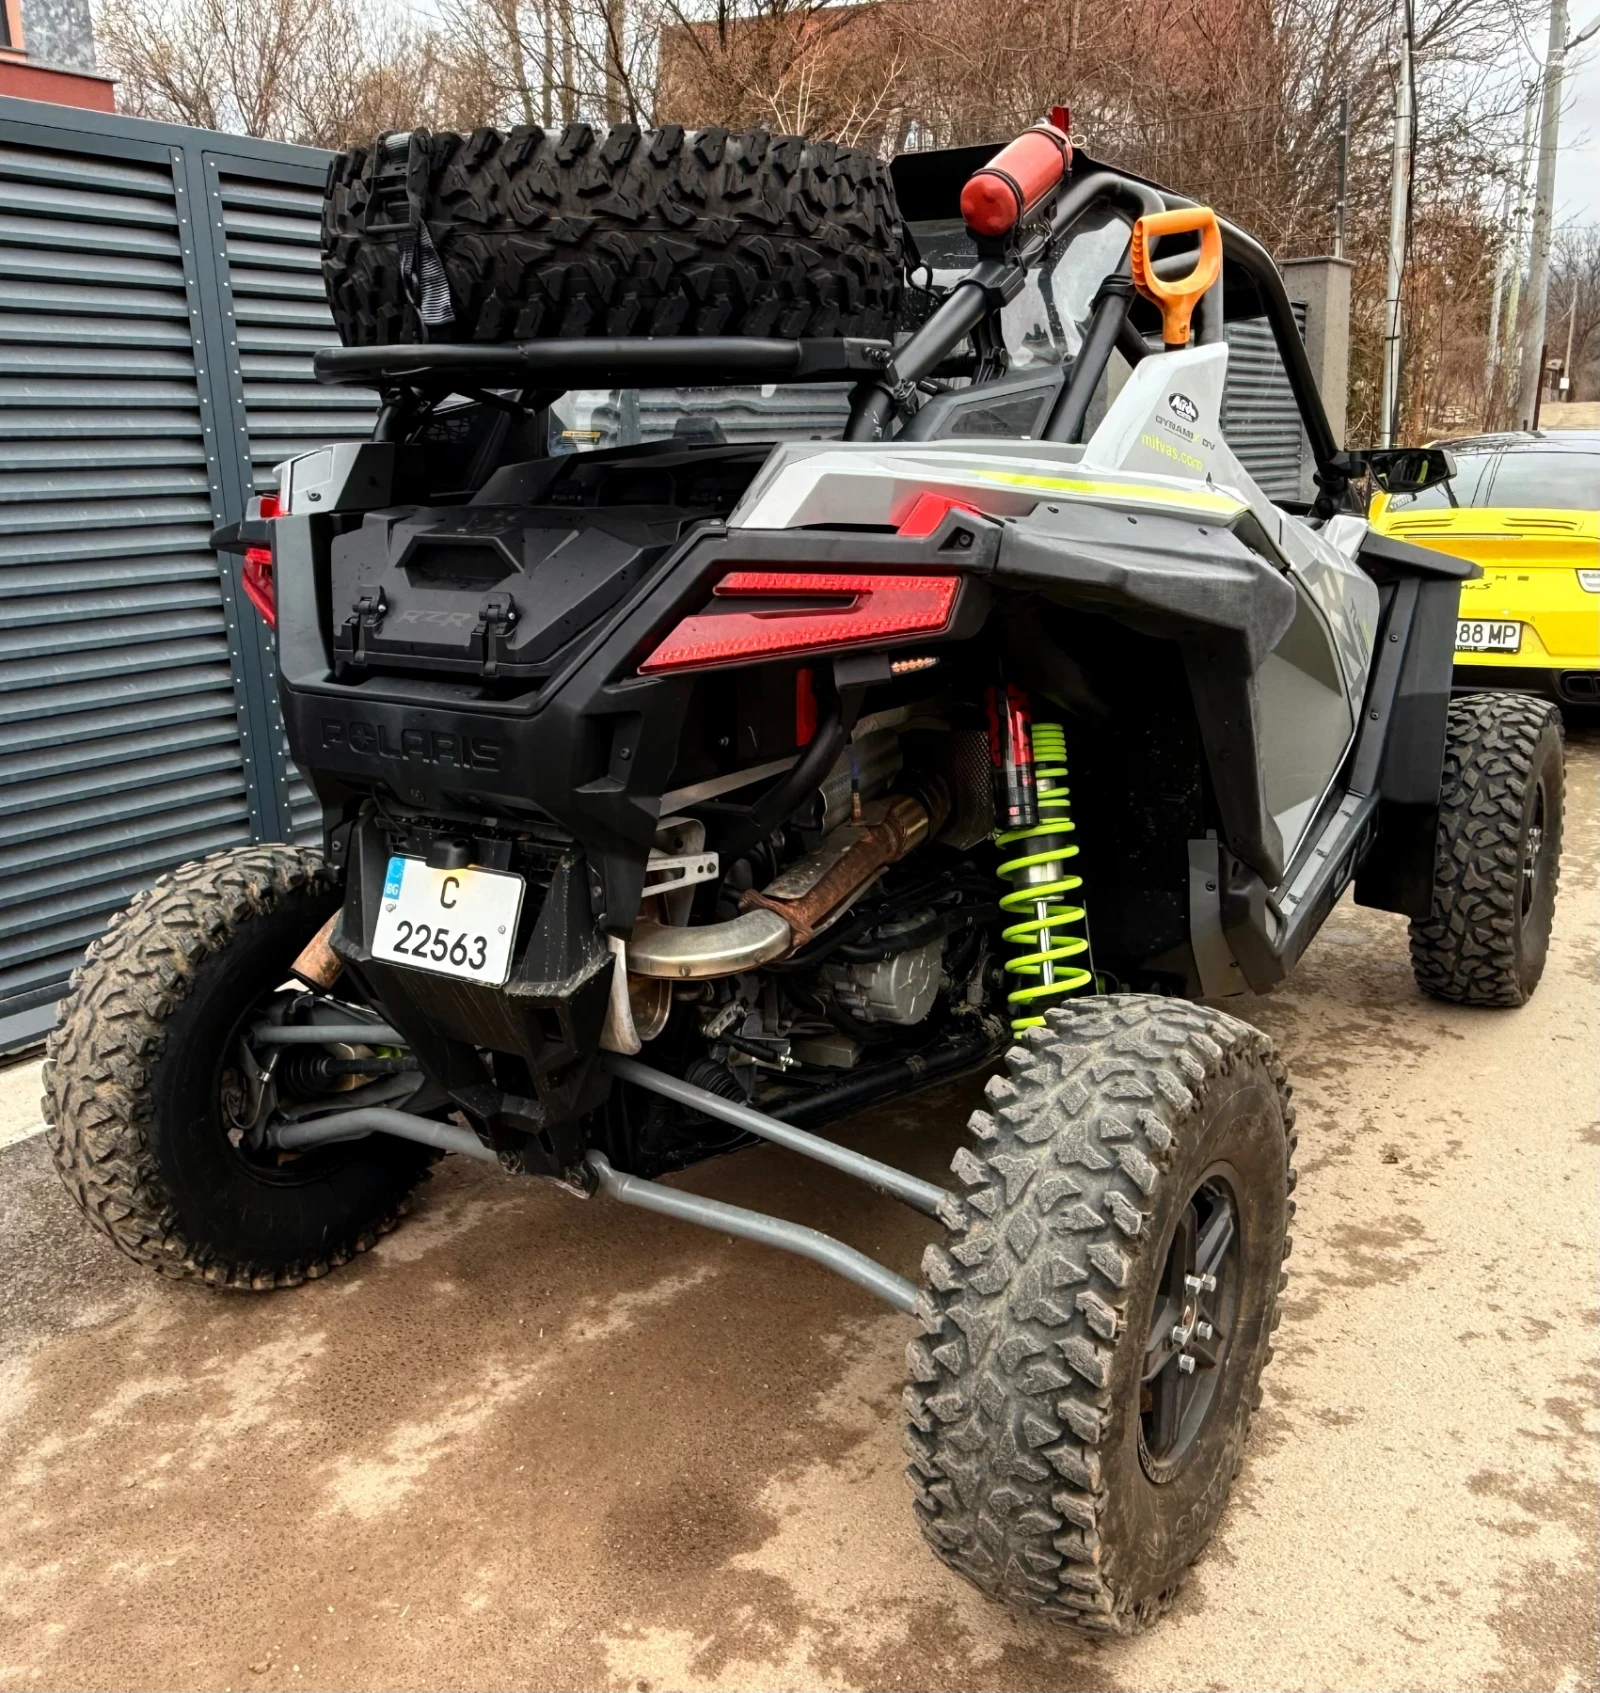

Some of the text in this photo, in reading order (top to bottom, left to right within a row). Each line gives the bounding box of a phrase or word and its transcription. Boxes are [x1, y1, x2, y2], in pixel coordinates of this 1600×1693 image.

[1141, 433, 1203, 471] mitvas.com
[396, 610, 474, 628] RZR
[1456, 623, 1517, 644] 88 MP
[321, 717, 500, 773] POLARIS
[385, 883, 399, 896] BG
[440, 876, 460, 909] C
[392, 920, 488, 970] 22563
